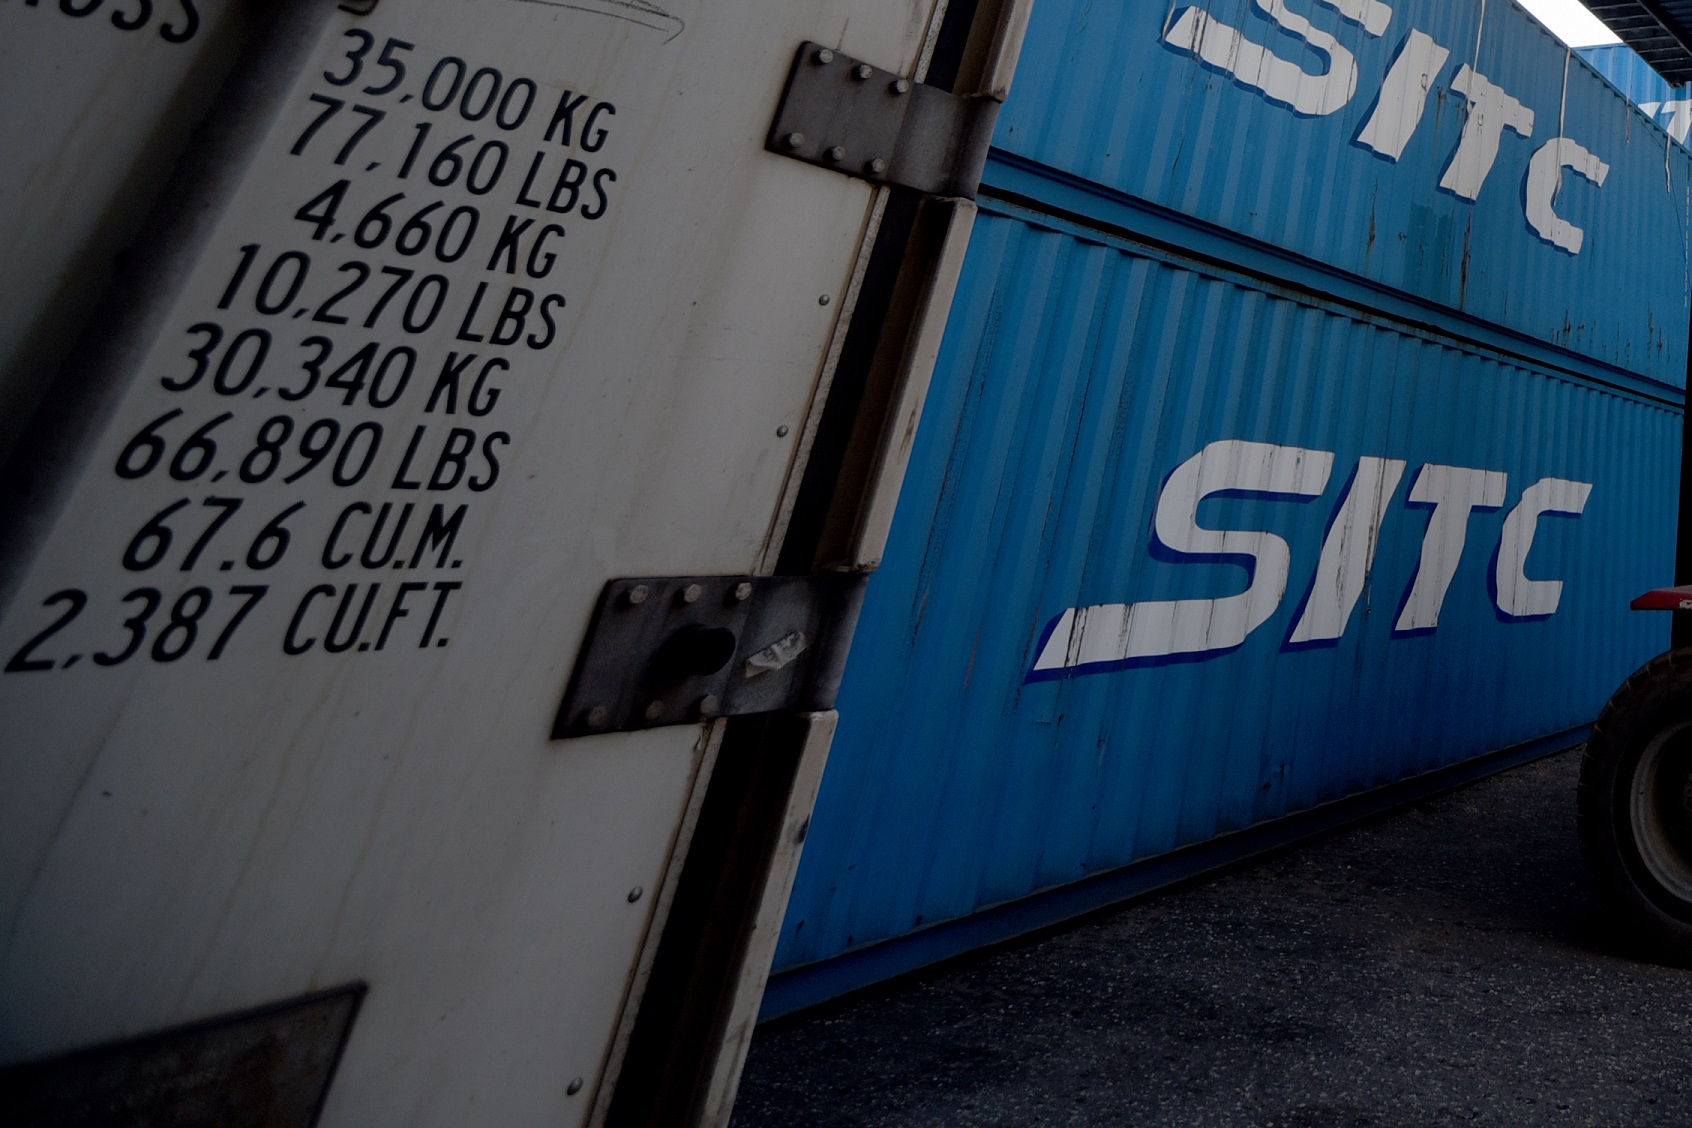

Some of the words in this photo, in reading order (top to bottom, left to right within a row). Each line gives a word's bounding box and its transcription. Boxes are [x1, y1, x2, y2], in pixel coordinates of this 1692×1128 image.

[323, 28, 538, 131] 35,000
[542, 90, 617, 153] KG
[290, 94, 510, 196] 77,160
[516, 152, 618, 220] LBS
[294, 179, 481, 263] 4,660
[486, 216, 566, 279] KG
[217, 243, 450, 334] 10,270
[457, 282, 566, 350] LBS
[160, 322, 418, 409] 30,340
[424, 353, 511, 417] KG
[114, 409, 383, 487] 66,890
[391, 425, 511, 493] LBS
[122, 497, 307, 573] 67.6
[1027, 437, 1593, 682] SITC
[4, 585, 270, 673] 2,387
